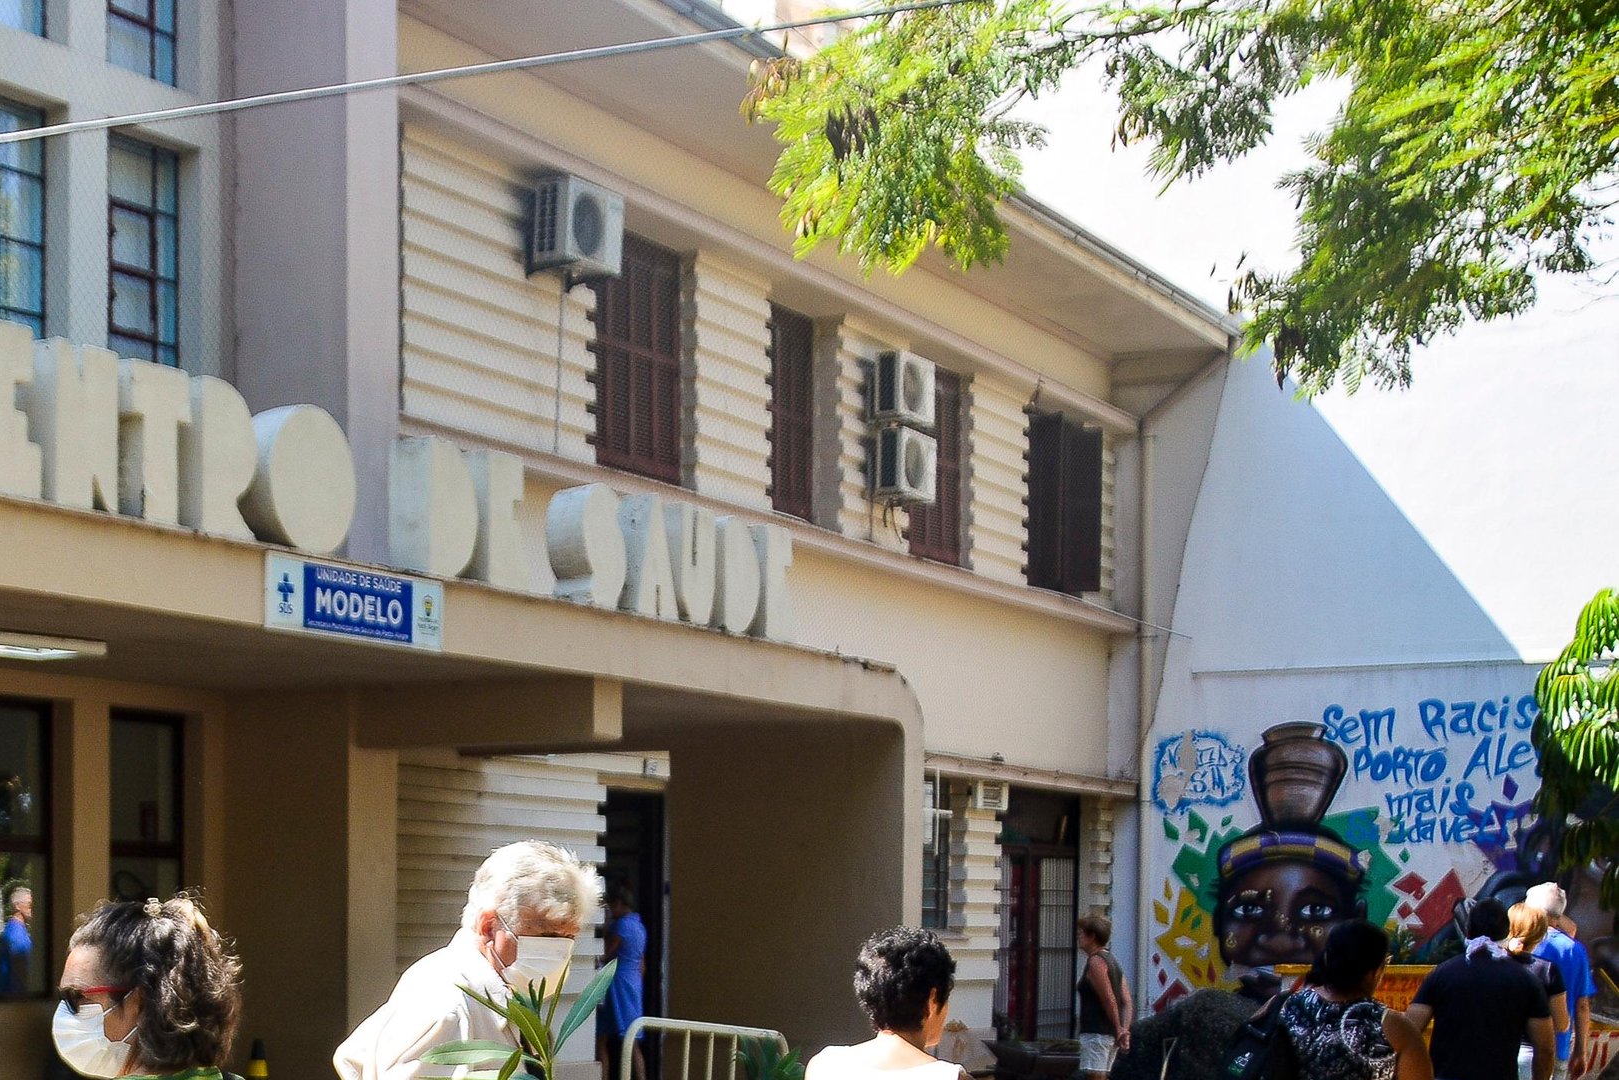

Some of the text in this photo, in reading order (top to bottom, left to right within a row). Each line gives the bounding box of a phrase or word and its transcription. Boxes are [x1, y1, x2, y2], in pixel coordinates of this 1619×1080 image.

[389, 434, 534, 593] DE
[316, 567, 403, 594] UNIDADE DE SAÚDE
[278, 602, 294, 616] SUS
[315, 586, 404, 625] MODELO
[1323, 703, 1396, 747] Sem
[1385, 777, 1475, 816] mais
